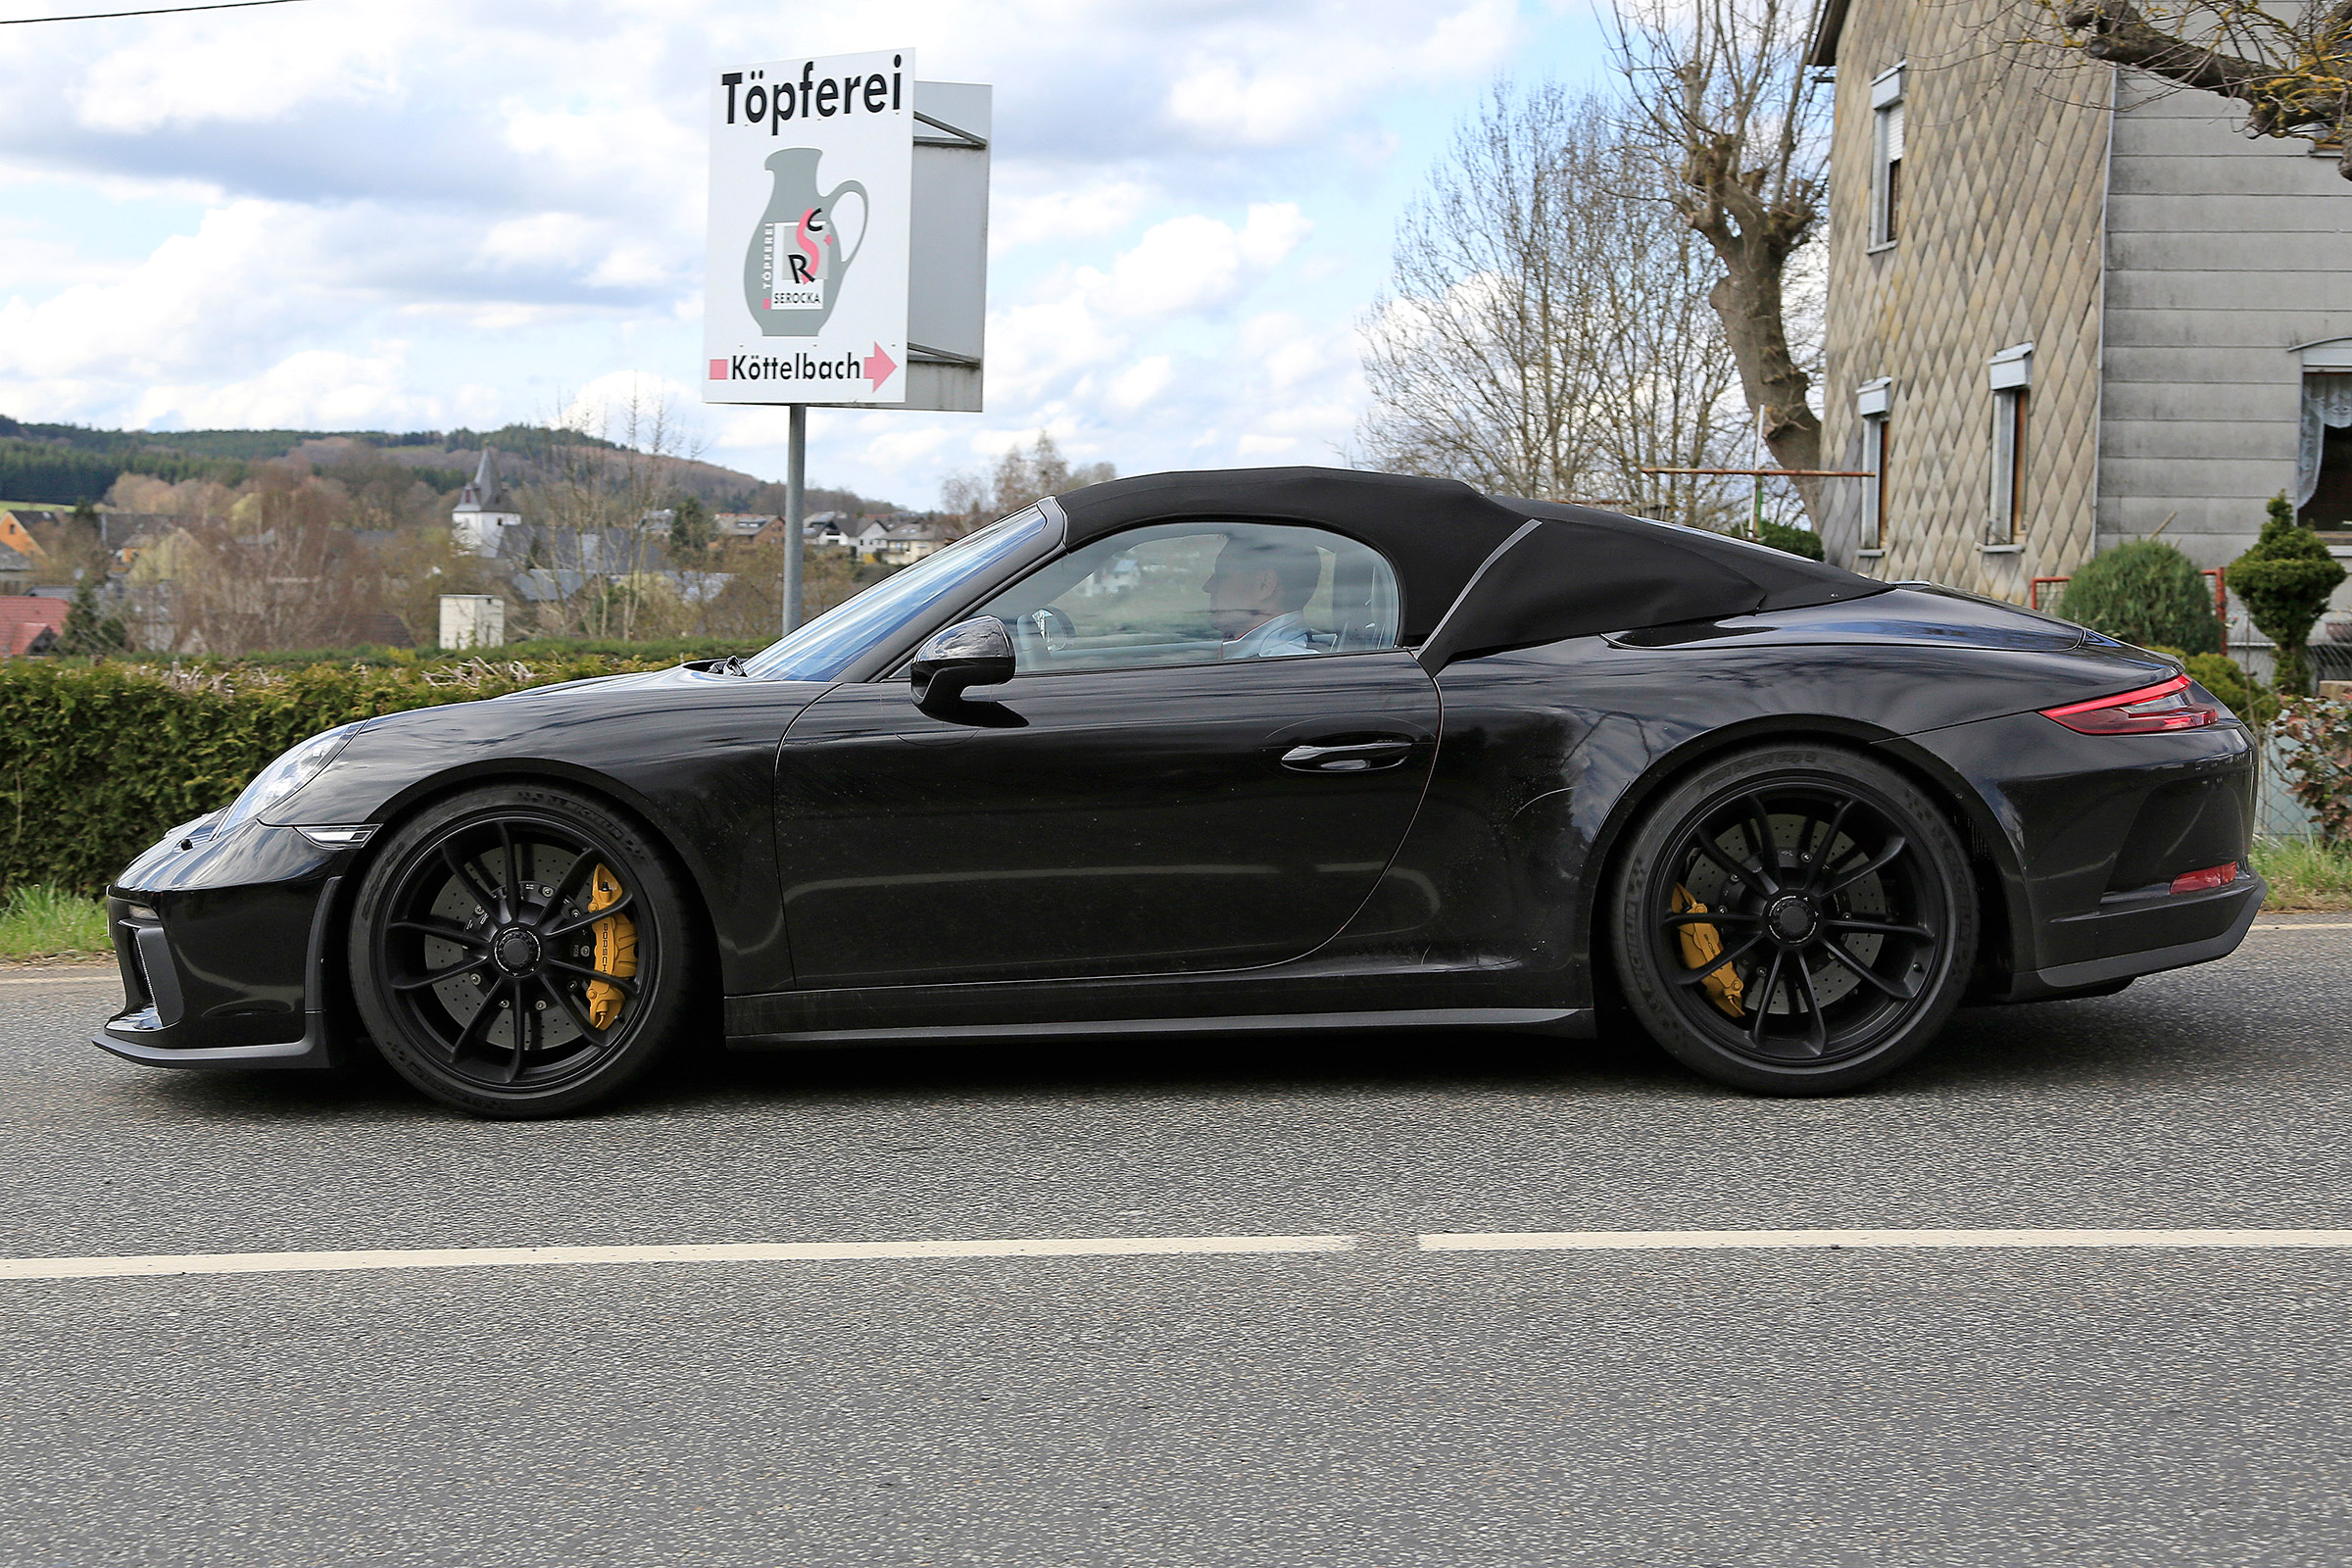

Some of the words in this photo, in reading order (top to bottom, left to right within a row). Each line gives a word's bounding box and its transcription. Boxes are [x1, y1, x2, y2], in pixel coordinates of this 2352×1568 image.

[721, 54, 902, 136] Töpferei
[773, 292, 821, 304] SEROCKA
[731, 352, 861, 380] Köttelbach
